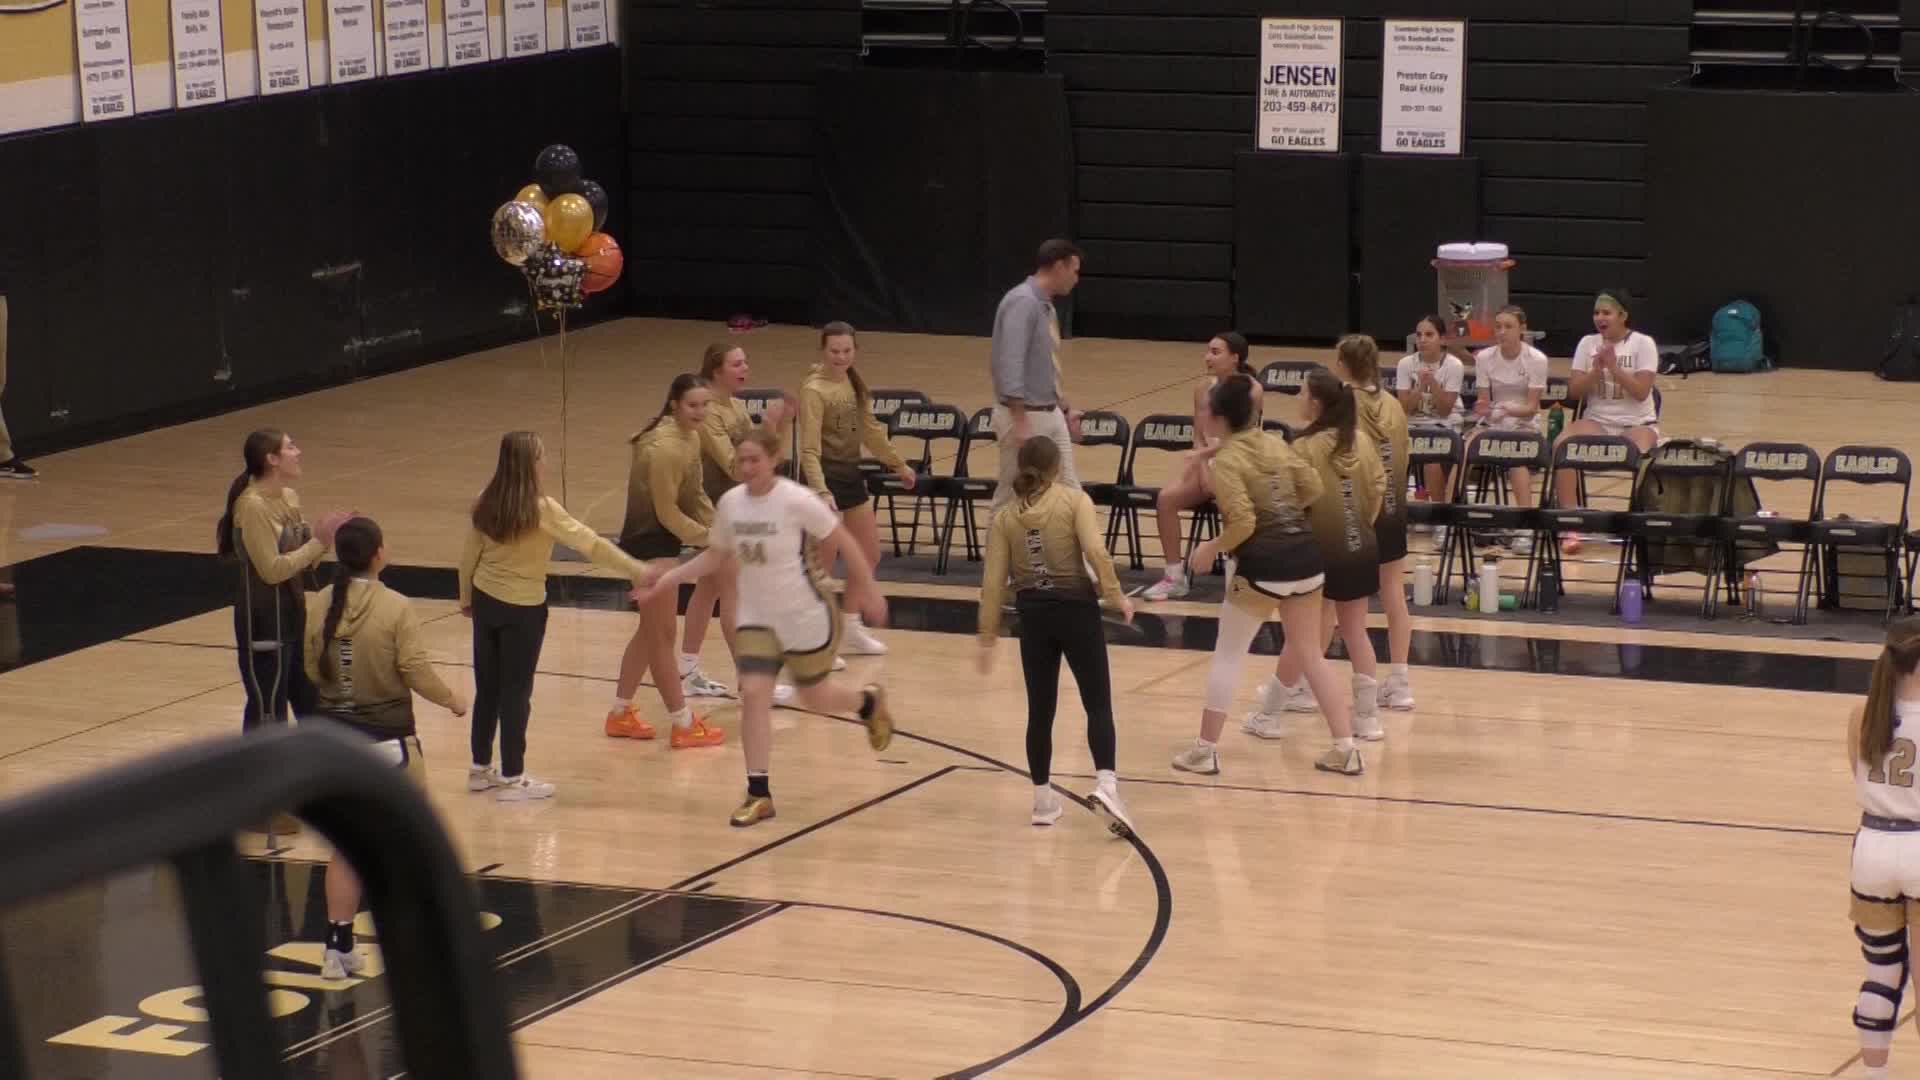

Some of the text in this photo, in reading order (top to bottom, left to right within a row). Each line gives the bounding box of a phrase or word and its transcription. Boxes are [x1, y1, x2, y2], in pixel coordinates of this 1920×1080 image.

[1264, 65, 1336, 86] JENSEN
[1397, 71, 1448, 82] Preston Gray
[1264, 88, 1336, 98] TIRE & AUTOMOTIVE
[1399, 83, 1444, 93] Real Estate
[1271, 135, 1325, 146] GO EAGLES
[1396, 137, 1445, 148] GO EAGLES
[898, 411, 955, 430] EAGLES
[1079, 419, 1118, 436] GLES
[1144, 423, 1194, 442] EAGLE
[1479, 439, 1539, 458] EAGLES
[1566, 443, 1628, 462] EAGLES
[1745, 451, 1808, 470] EAGLES
[1835, 455, 1899, 474] EAGLES
